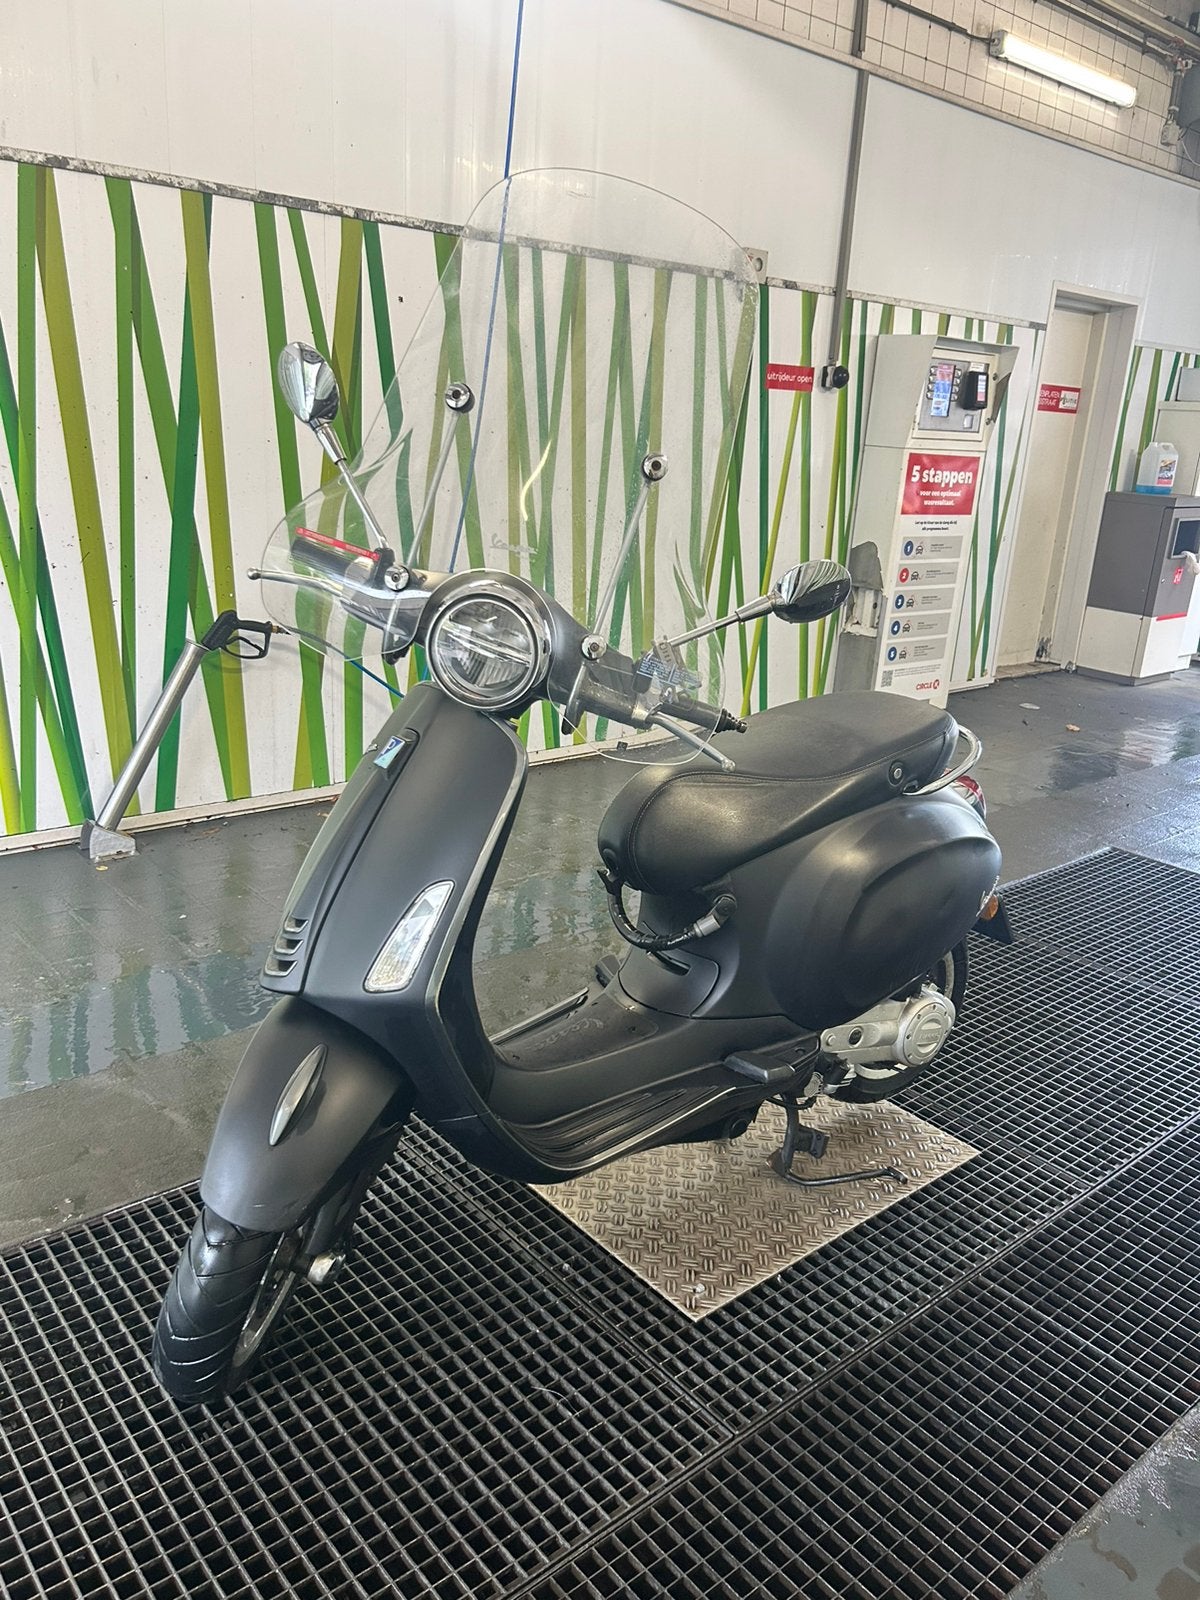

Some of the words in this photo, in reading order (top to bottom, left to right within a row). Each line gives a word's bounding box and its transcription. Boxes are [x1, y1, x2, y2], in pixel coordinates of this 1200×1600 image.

[767, 371, 796, 382] uitrijdeur
[797, 376, 813, 384] open
[911, 465, 921, 482] 5
[922, 468, 973, 487] stappen
